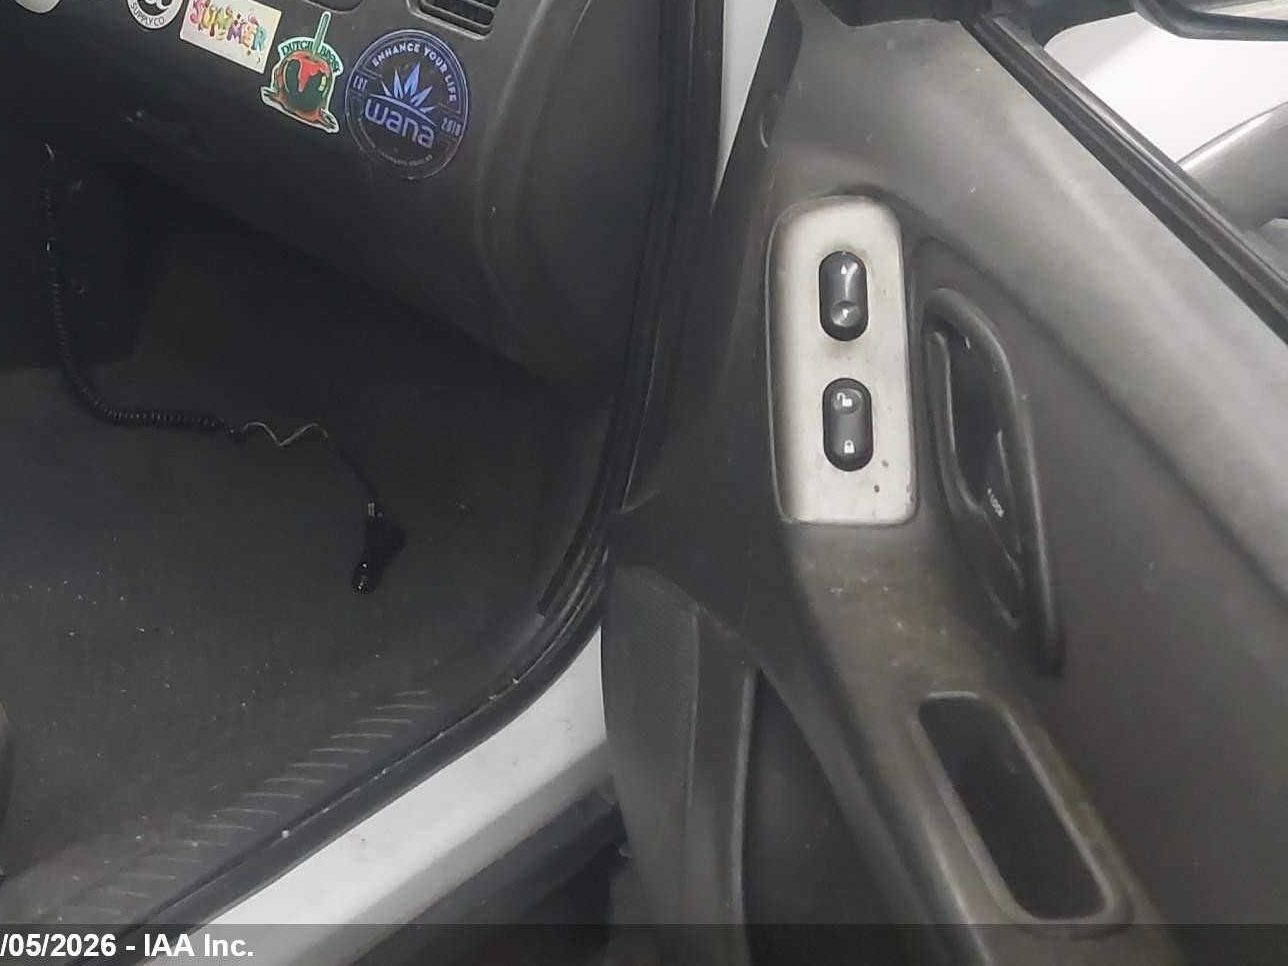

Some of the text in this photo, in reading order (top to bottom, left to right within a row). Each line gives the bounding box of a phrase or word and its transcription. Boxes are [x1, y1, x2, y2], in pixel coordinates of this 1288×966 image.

[280, 40, 315, 56] DUTCH
[371, 42, 458, 102] ENHANCE YOUR LIFE
[364, 98, 435, 150] wana
